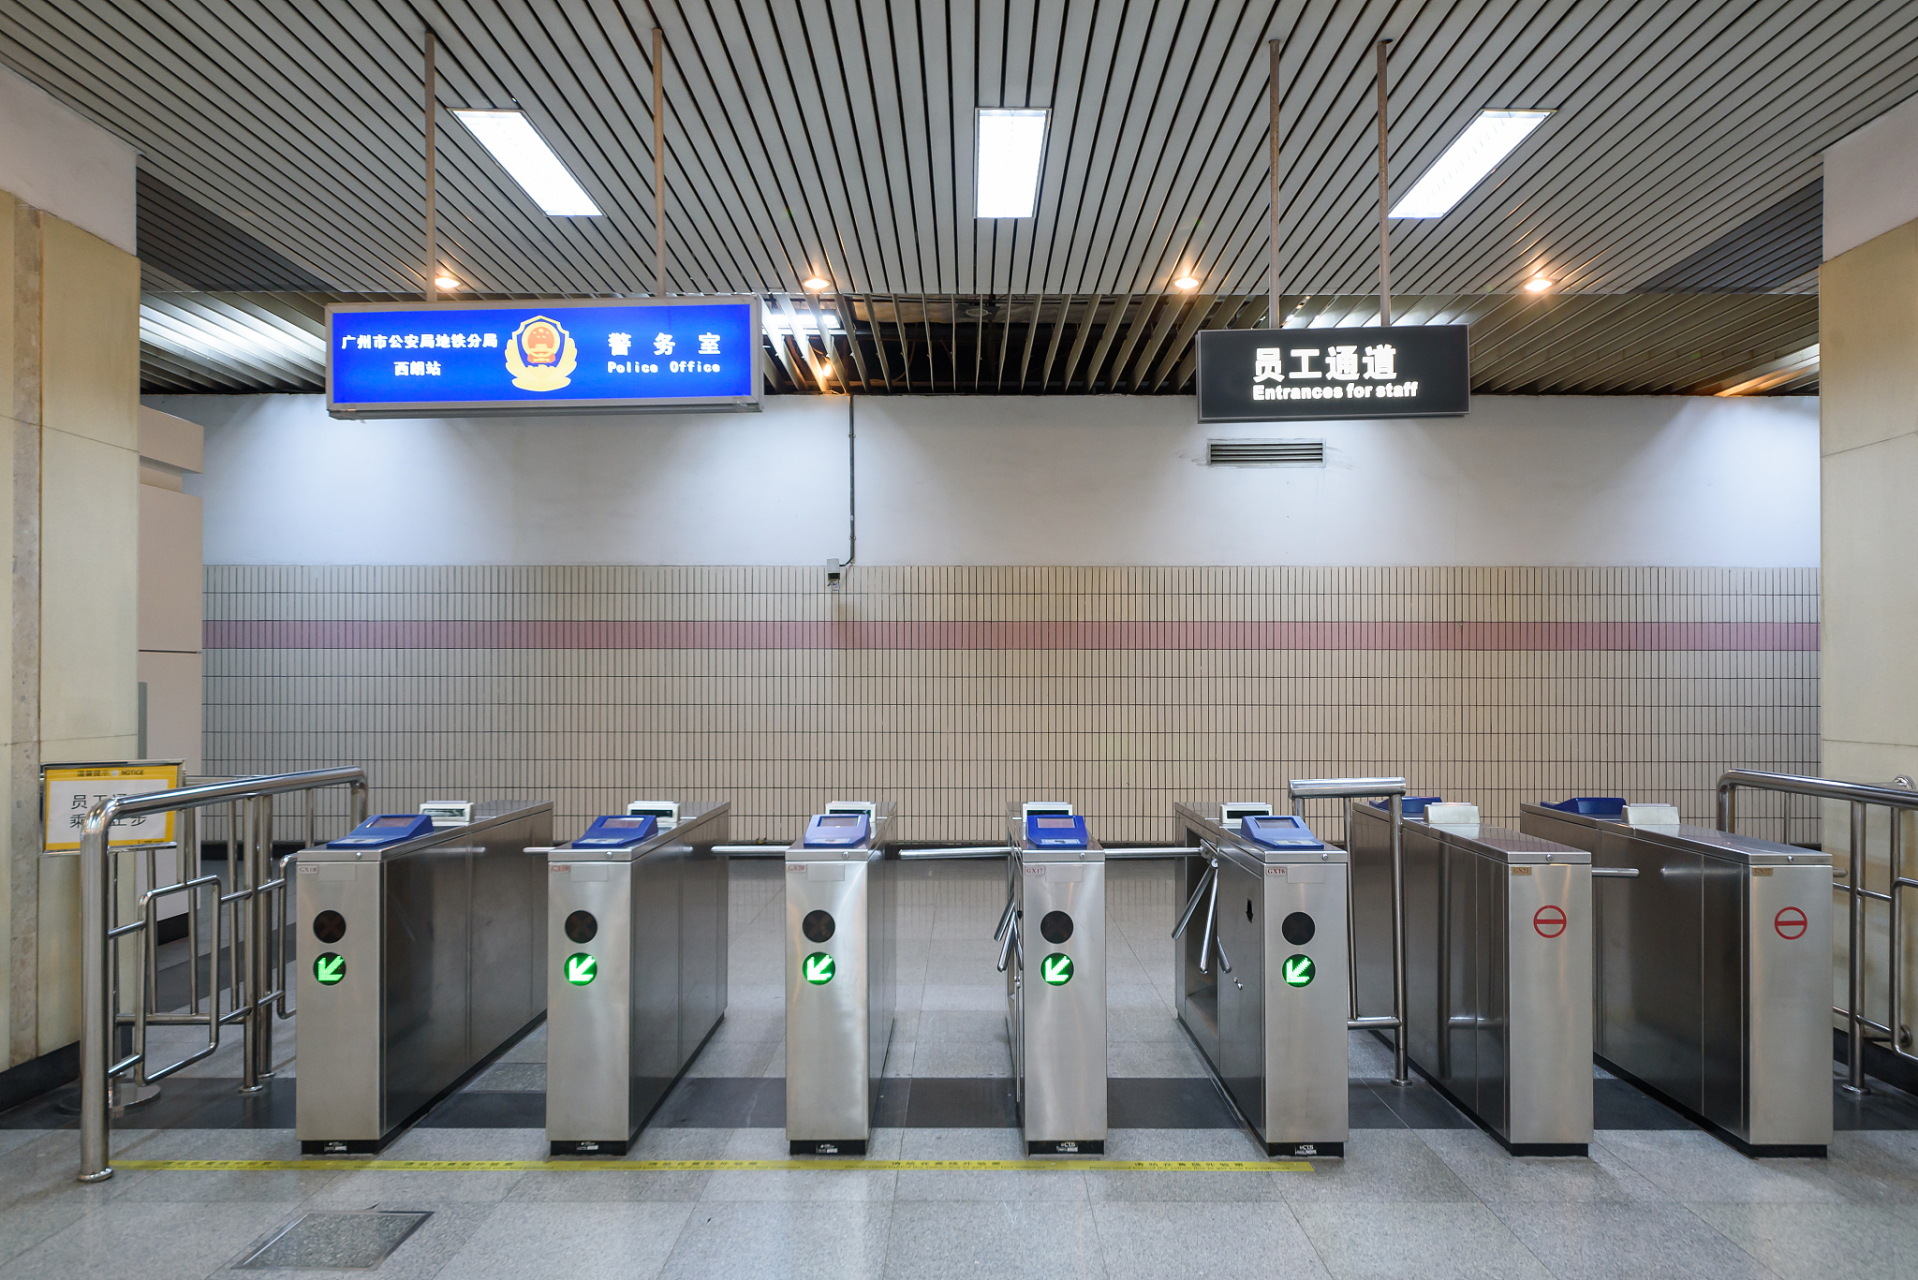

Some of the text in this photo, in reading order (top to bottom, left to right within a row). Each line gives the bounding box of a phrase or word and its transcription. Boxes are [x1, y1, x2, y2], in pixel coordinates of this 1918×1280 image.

[342, 333, 498, 349] 广州市公安局地铁分局
[608, 332, 721, 356] 警务室
[394, 361, 442, 376] 西朗站
[607, 360, 721, 373] Police Office
[1253, 344, 1397, 383] 员工通道
[1253, 381, 1419, 400] Entrances for staff
